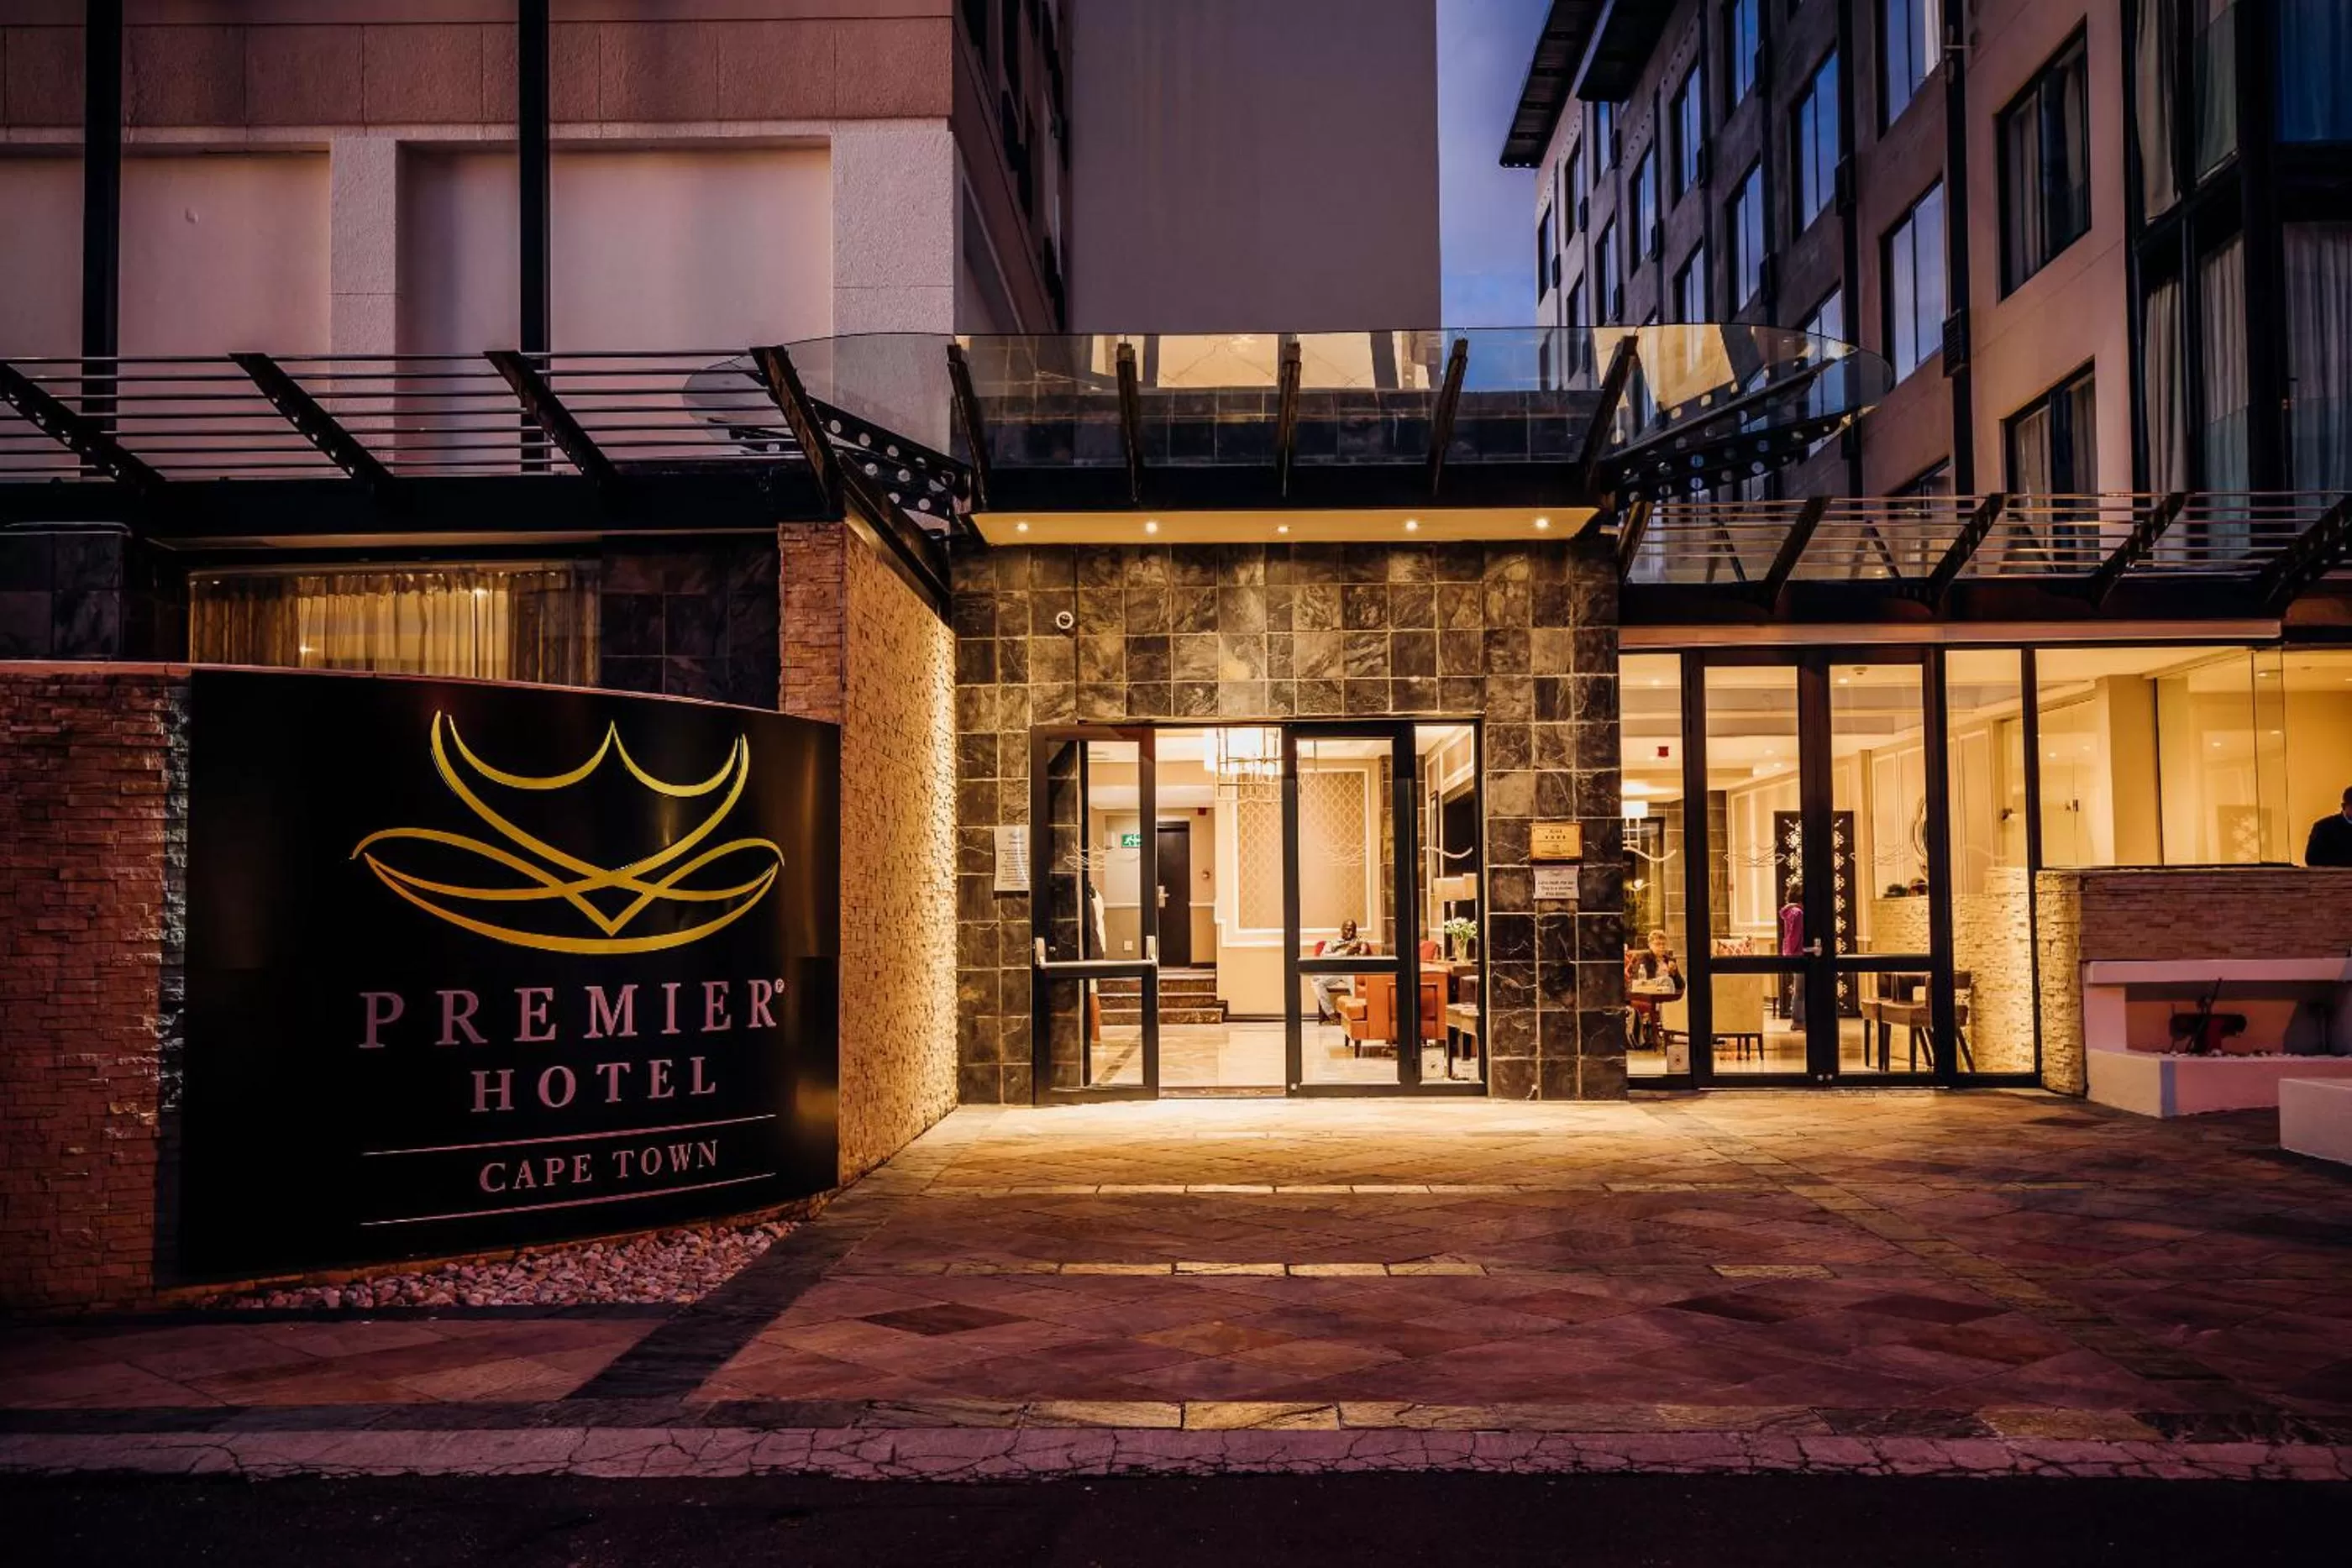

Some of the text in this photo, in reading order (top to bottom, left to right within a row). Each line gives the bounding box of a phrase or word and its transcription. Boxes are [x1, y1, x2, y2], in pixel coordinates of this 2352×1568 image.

[470, 1056, 717, 1114] HOTEL
[478, 1139, 719, 1193] CAPE TOWN
